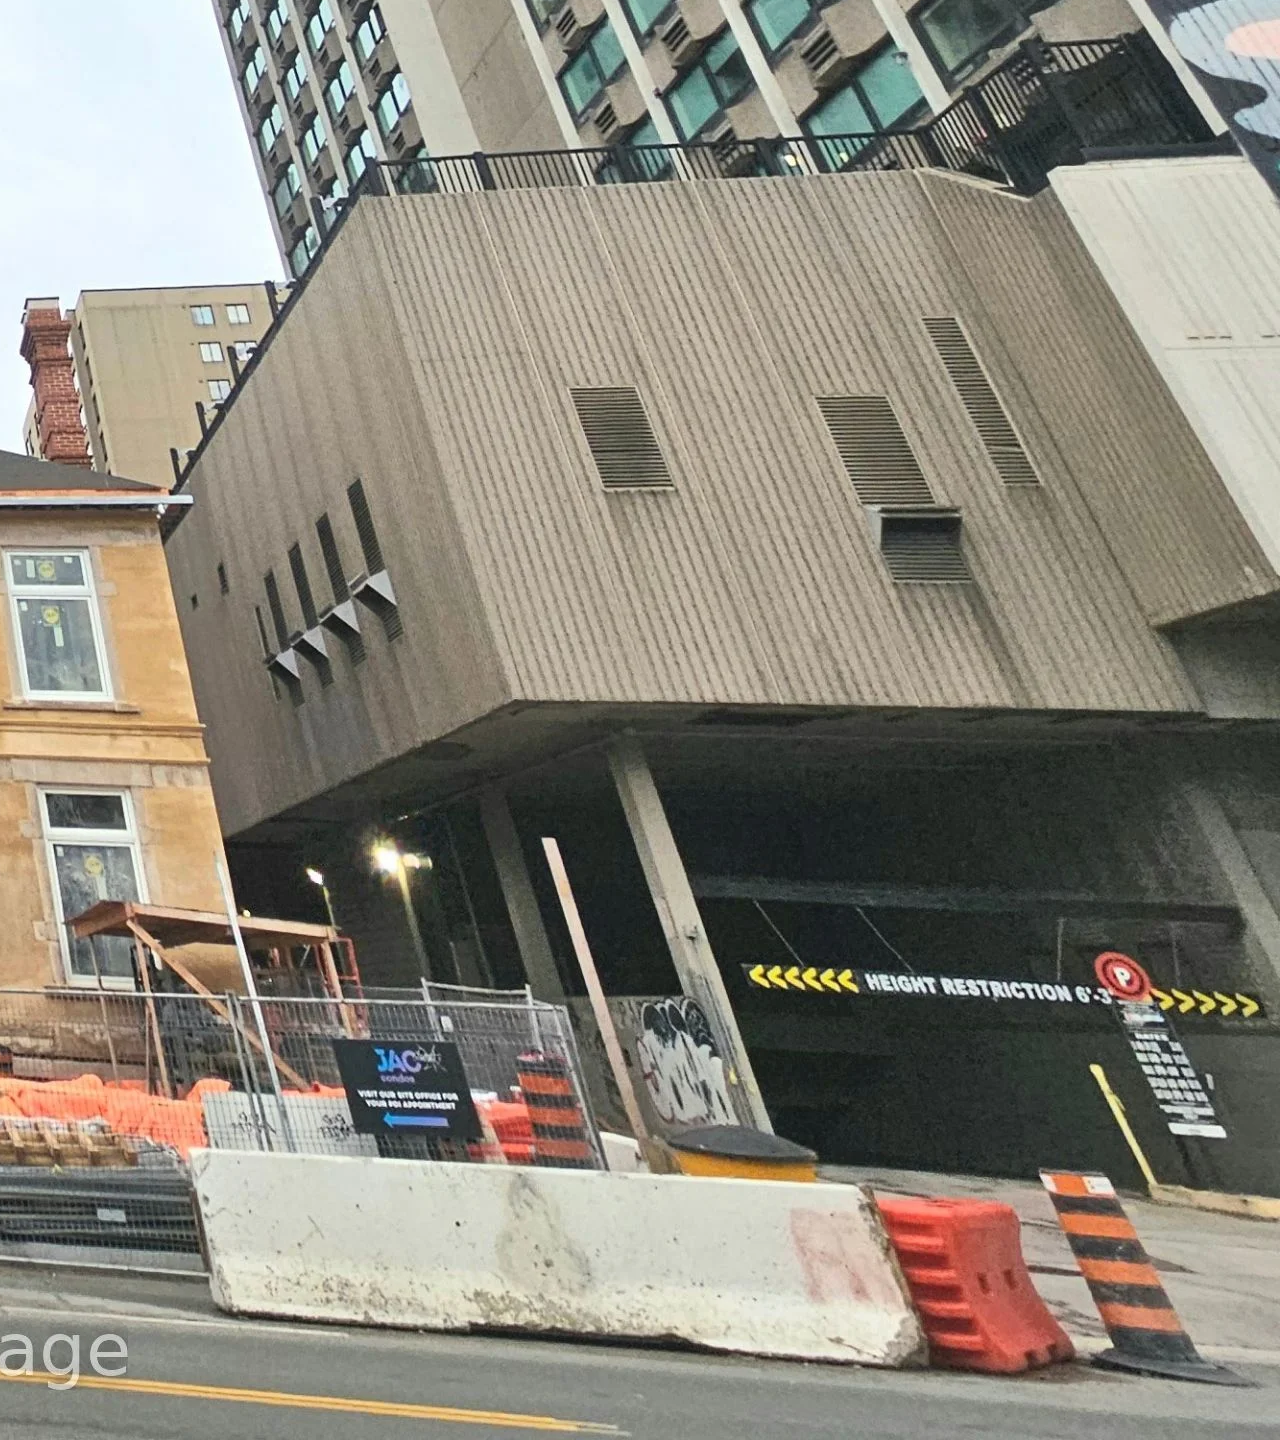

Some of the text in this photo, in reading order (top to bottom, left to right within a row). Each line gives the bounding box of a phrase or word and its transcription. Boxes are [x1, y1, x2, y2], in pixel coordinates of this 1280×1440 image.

[1113, 966, 1131, 987] P
[864, 973, 937, 994] HEIGHT
[939, 977, 1073, 1002] RESTRICTION
[374, 1048, 422, 1072] JAC
[357, 1090, 459, 1101] VISIT OUR SITE OFFICE FOR
[365, 1099, 388, 1108] YOUR
[403, 1101, 456, 1110] APPOINTMENT
